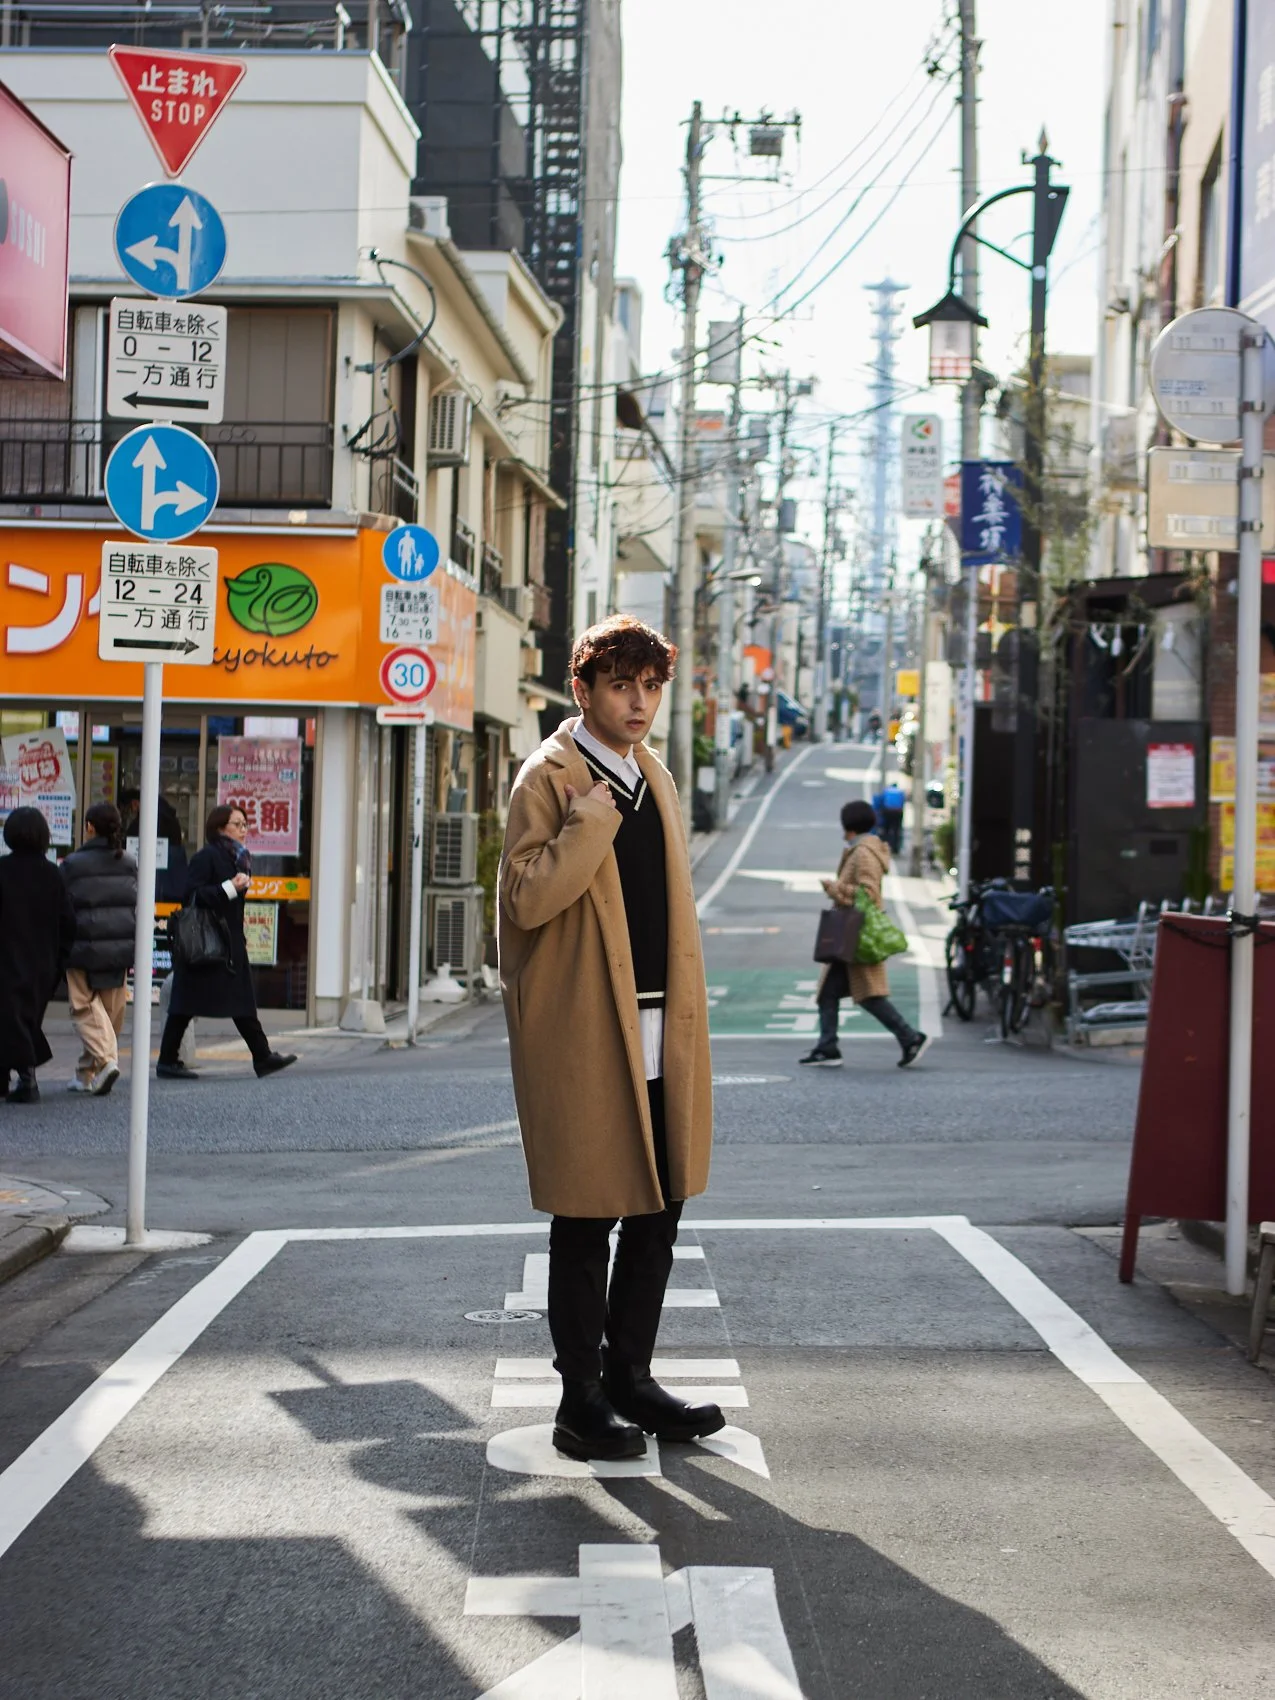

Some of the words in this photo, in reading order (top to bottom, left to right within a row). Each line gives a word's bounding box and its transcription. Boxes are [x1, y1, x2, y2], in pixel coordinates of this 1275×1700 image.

[137, 64, 218, 98] 止まれ
[151, 100, 206, 126] STOP
[117, 309, 219, 336] 自転車を除く
[123, 336, 138, 357] 0
[191, 341, 214, 363] 12
[116, 364, 219, 390] 一方通行
[108, 552, 211, 578] 自転車を除く
[115, 580, 136, 601] 12
[174, 583, 204, 605] 24
[107, 608, 210, 631] 一方通行
[422, 615, 430, 627] 9
[386, 627, 399, 639] 16
[419, 628, 433, 640] 18
[394, 663, 424, 687] 30
